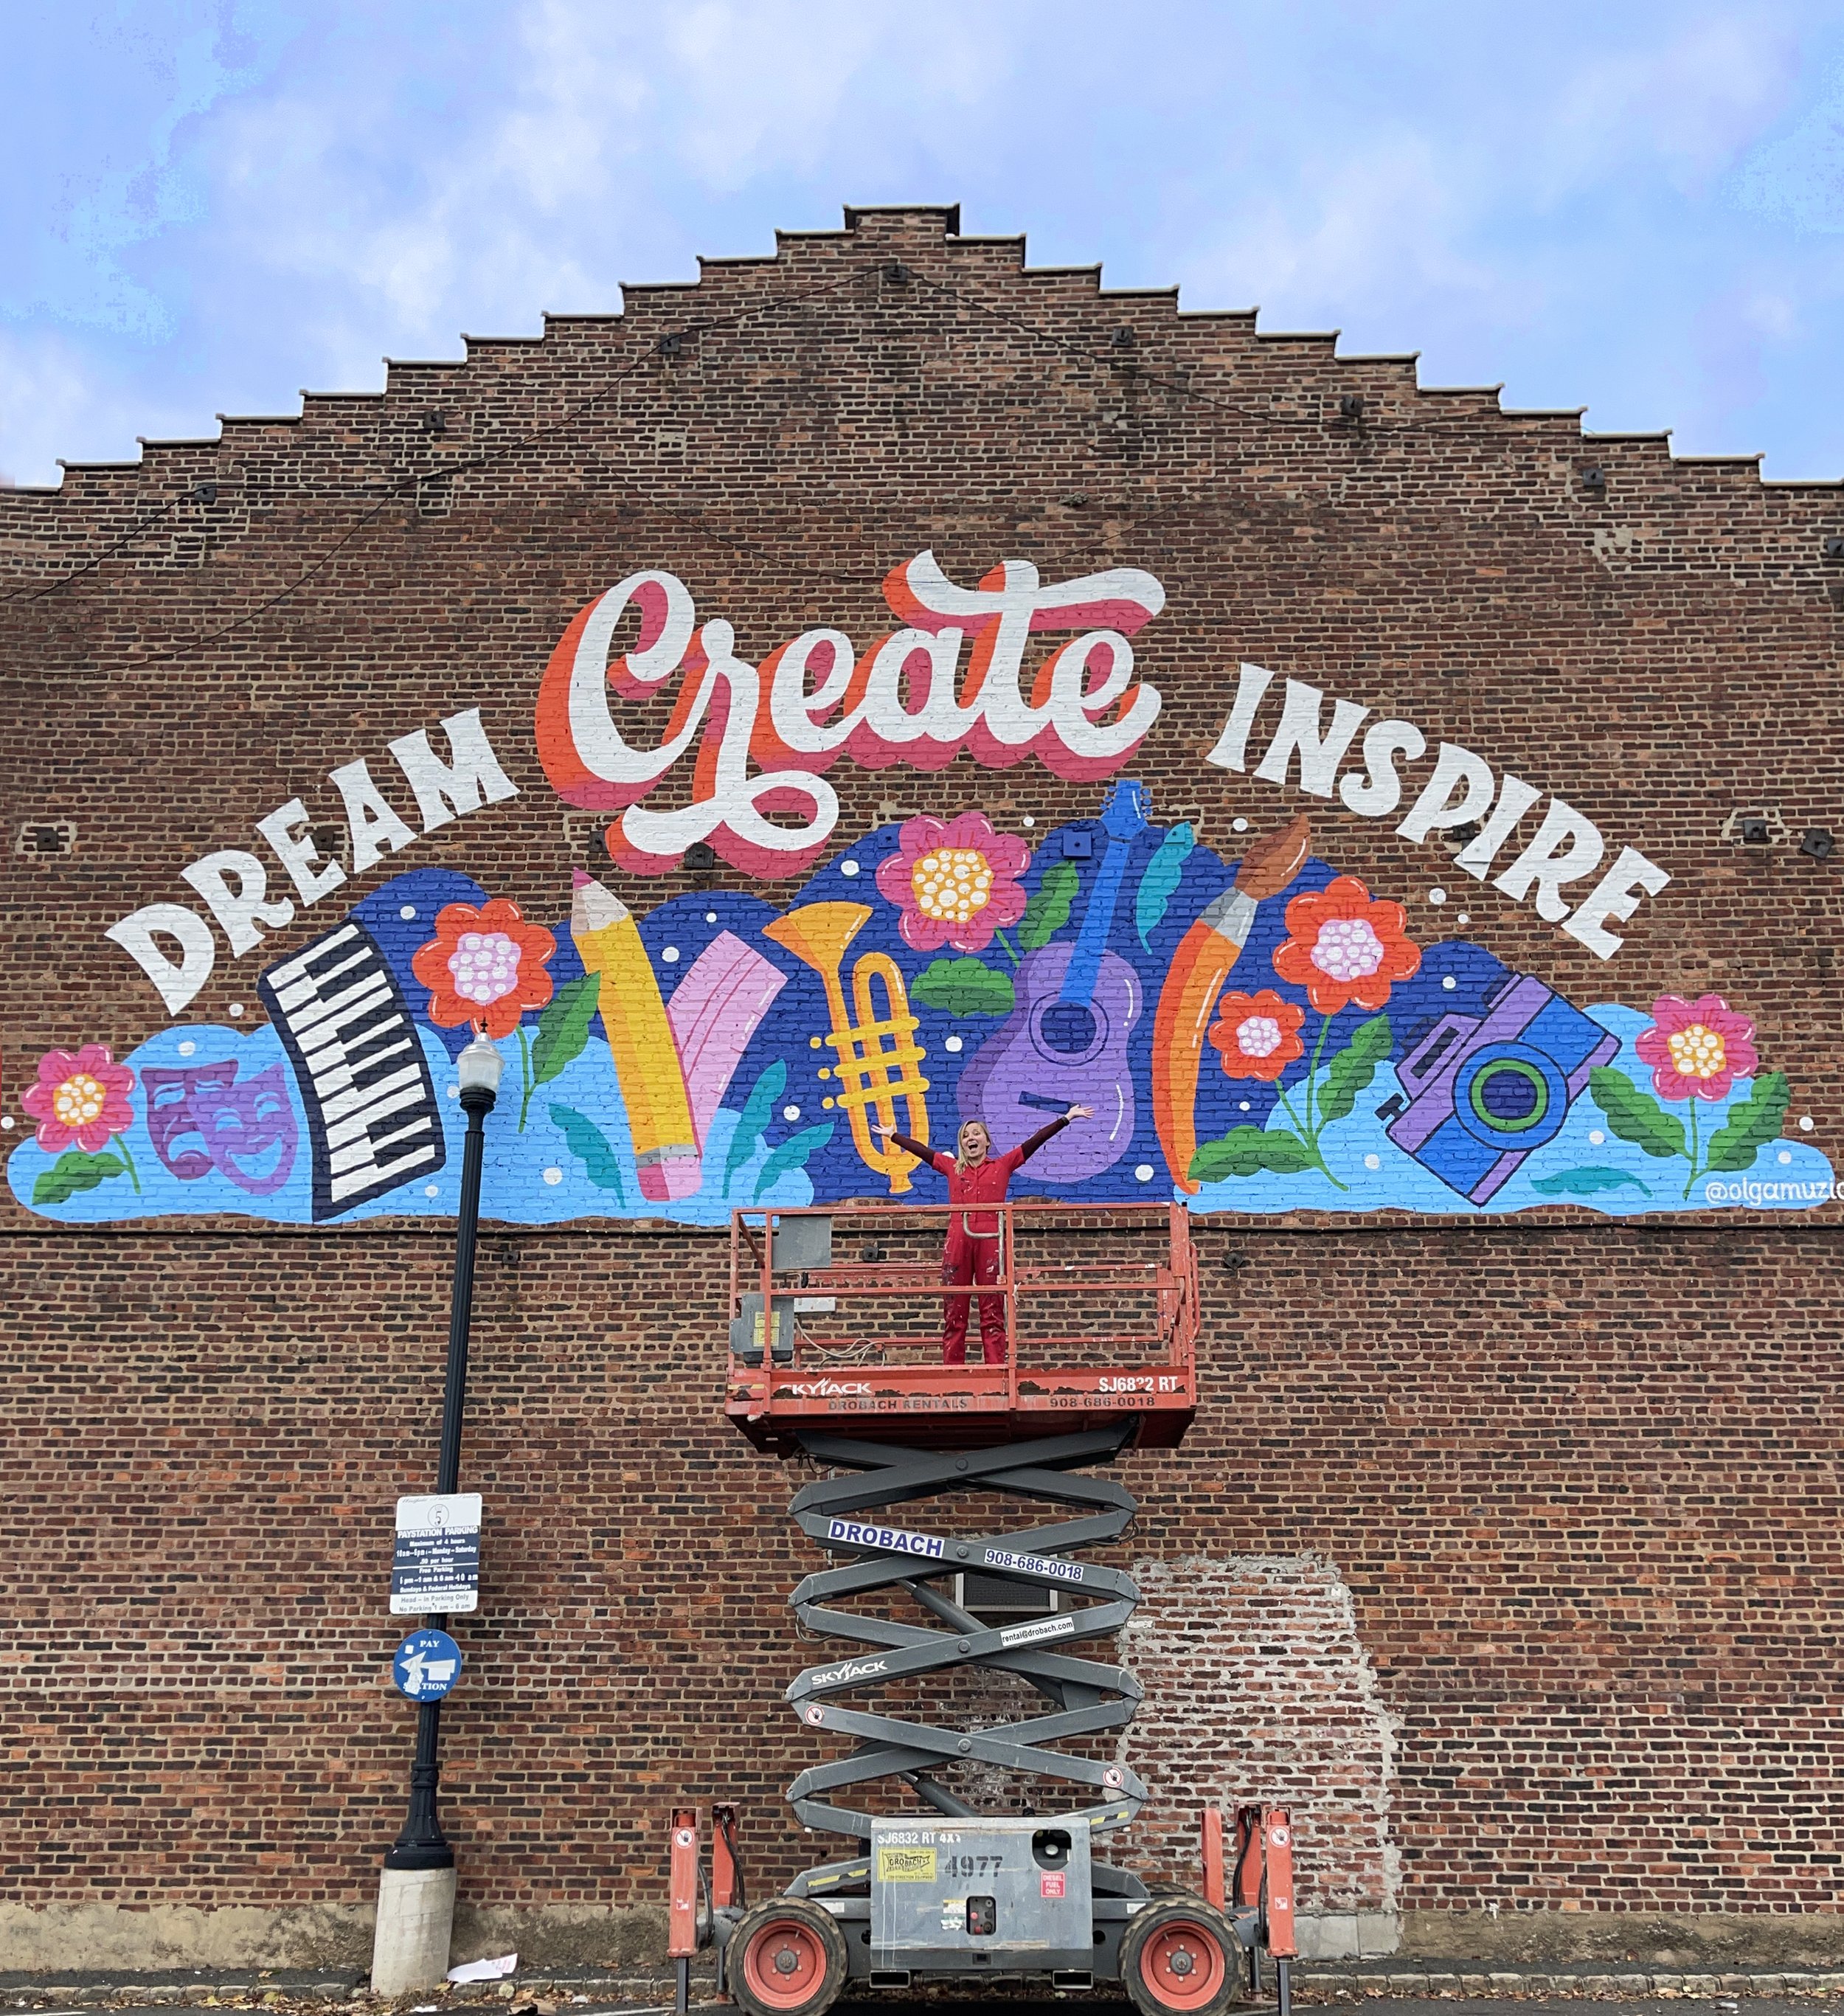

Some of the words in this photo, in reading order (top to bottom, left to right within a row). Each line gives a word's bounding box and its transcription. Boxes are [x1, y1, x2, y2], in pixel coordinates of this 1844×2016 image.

[537, 550, 1166, 878] Create
[1205, 662, 1672, 961] INSPIRE
[103, 707, 521, 1017] DREAM
[1159, 1376, 1178, 1392] RT
[828, 1399, 897, 1411] DROBACH
[903, 1398, 968, 1410] RENTALS
[1050, 1397, 1156, 1407] 908-686-0018
[434, 1511, 443, 1525] 5
[398, 1528, 443, 1538] PAYSTATION
[444, 1525, 479, 1536] PARKING
[831, 1521, 943, 1556] DROBACH
[986, 1550, 1081, 1579] 908-686-0018
[409, 1604, 432, 1613] Parking
[1002, 1621, 1073, 1643] rental@drobach.com
[811, 1660, 887, 1686] SKYJACK
[403, 1682, 447, 1690] TION
[878, 1832, 918, 1844] SJ6832
[922, 1831, 936, 1843] RT
[945, 1855, 1003, 1877] 4977
